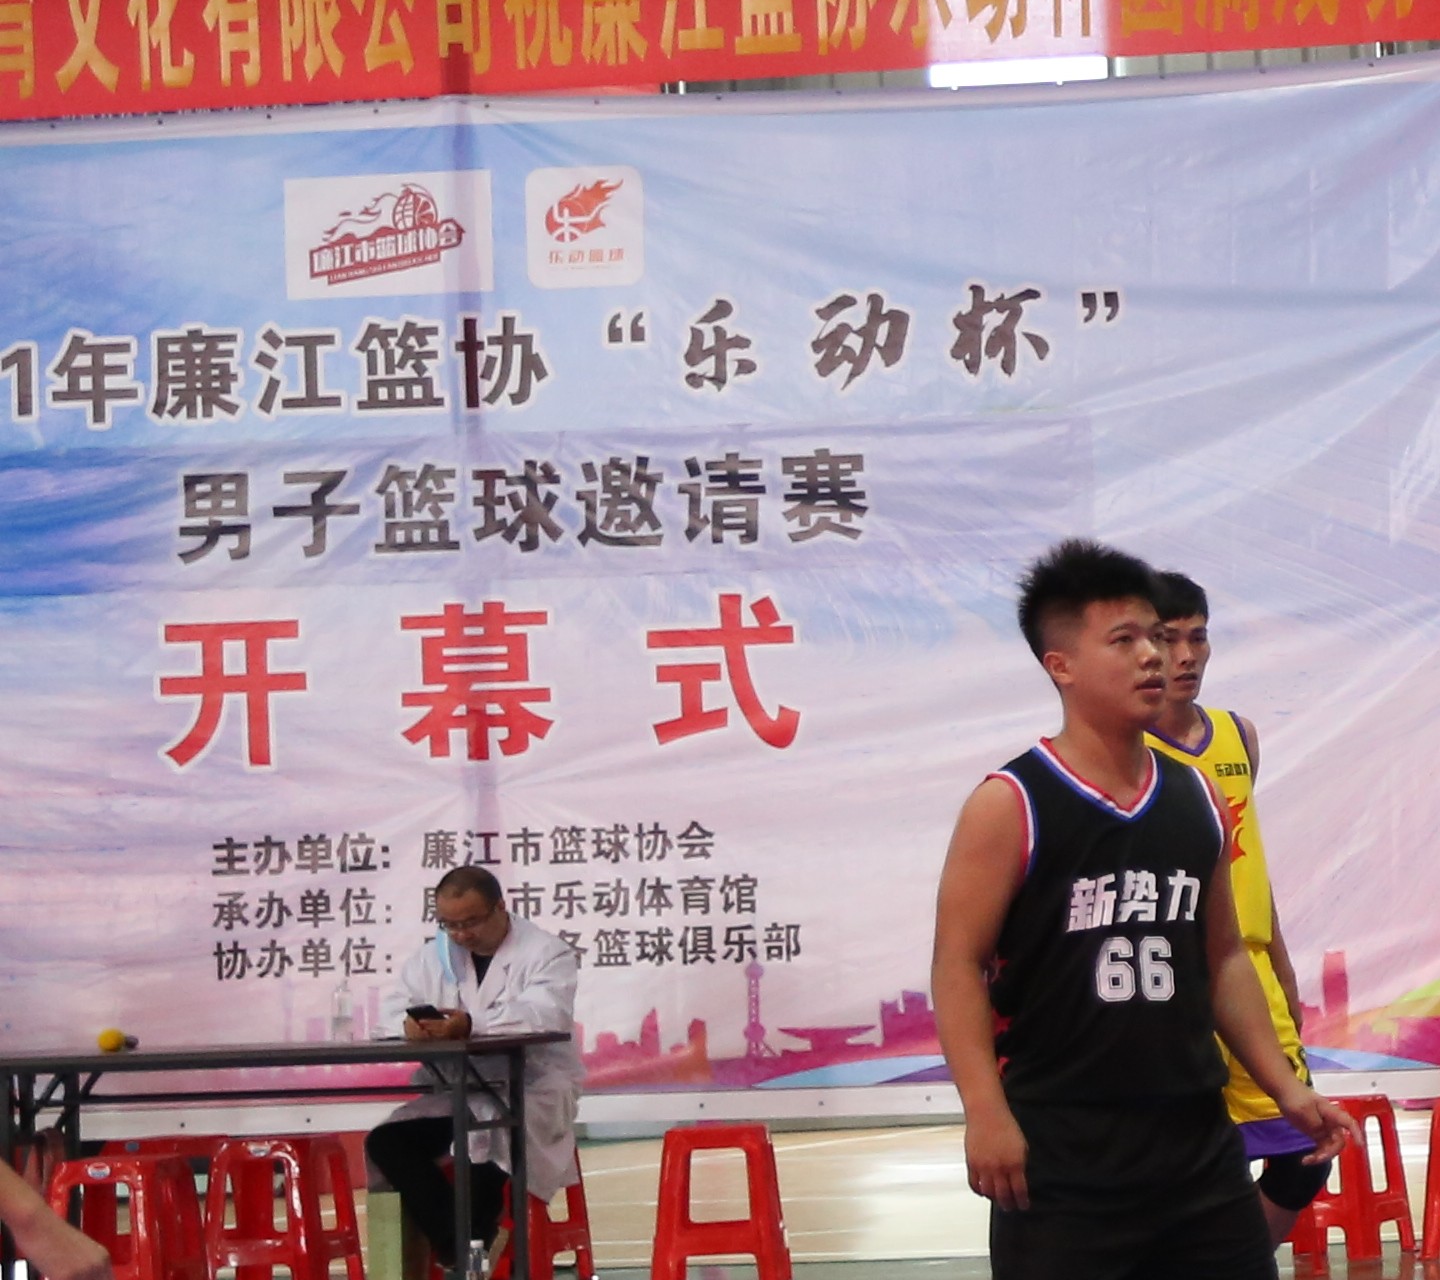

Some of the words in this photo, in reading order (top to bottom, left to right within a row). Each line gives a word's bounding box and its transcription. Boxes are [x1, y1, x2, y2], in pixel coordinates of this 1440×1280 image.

[178, 448, 869, 563] 男子篮球邀请赛
[159, 594, 801, 768] 开幕式
[212, 873, 758, 931] 承办单位：市乐动体育馆
[1065, 869, 1200, 932] 新势力
[1095, 936, 1174, 1002] 66
